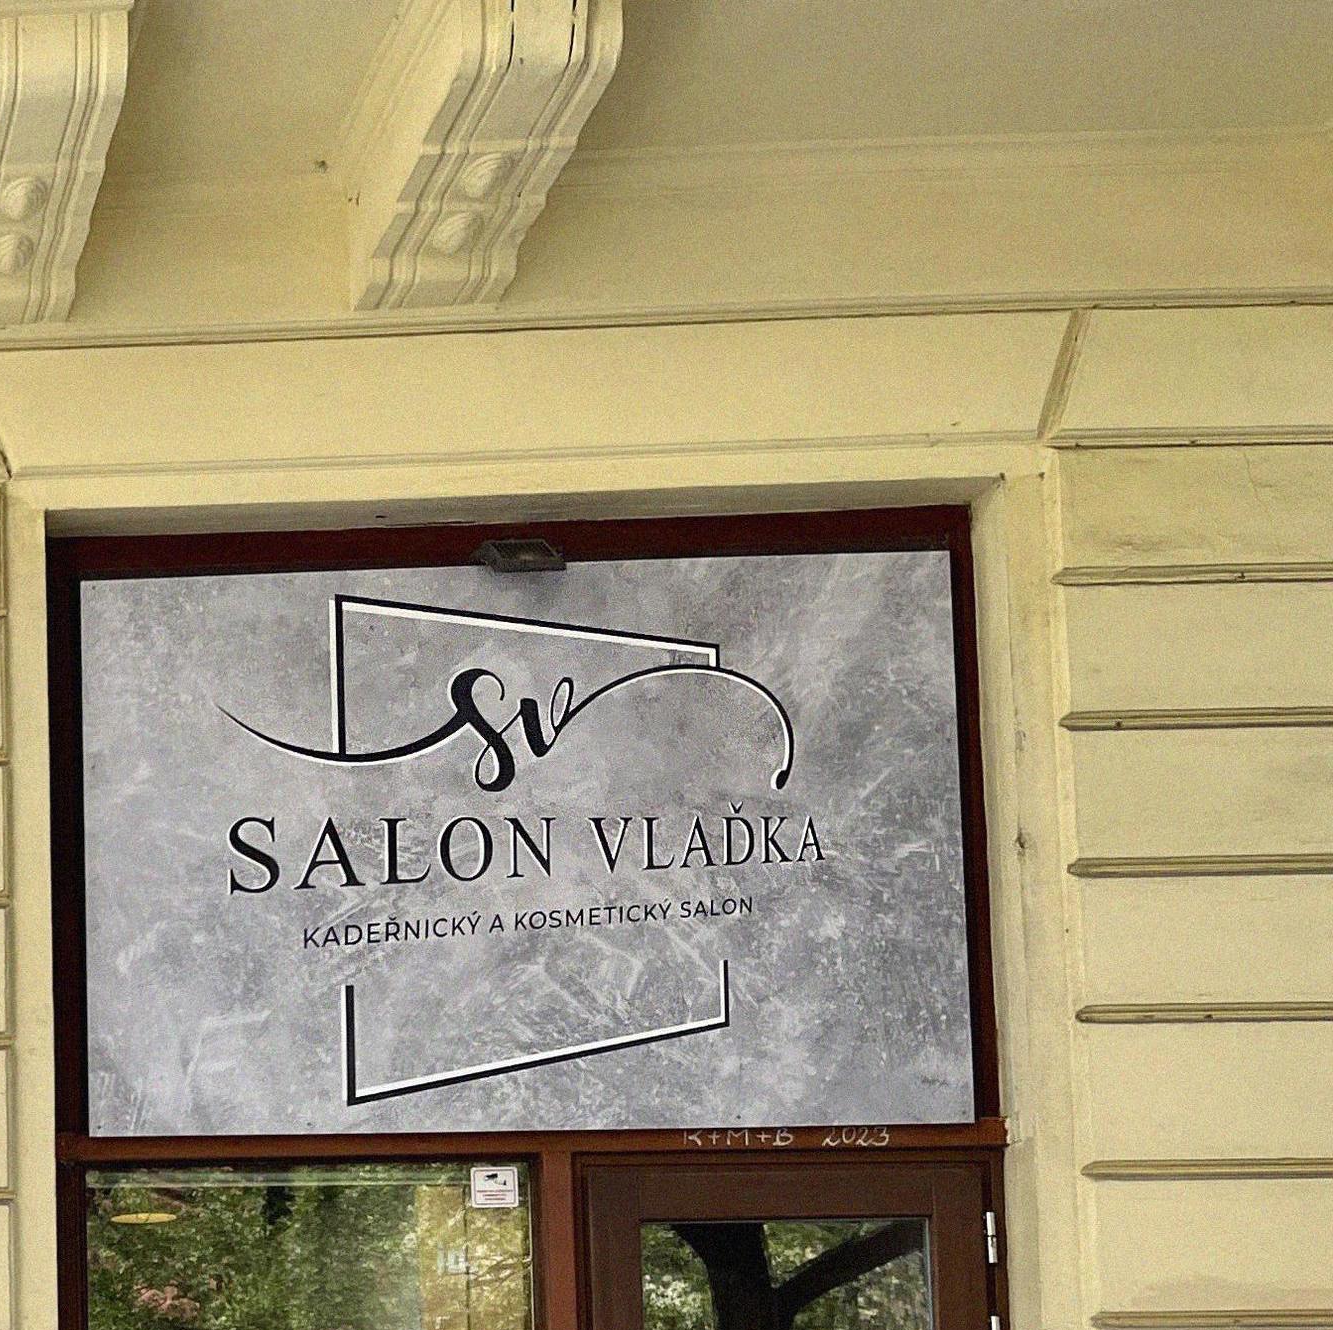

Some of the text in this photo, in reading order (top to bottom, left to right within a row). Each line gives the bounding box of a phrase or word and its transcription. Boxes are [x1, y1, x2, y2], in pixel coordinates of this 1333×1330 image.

[227, 802, 827, 896] SALON VLAĎKA
[302, 896, 755, 950] KADEŘNICKÝ A KOSMETICKÝ SALON
[821, 1125, 890, 1148] 2023
